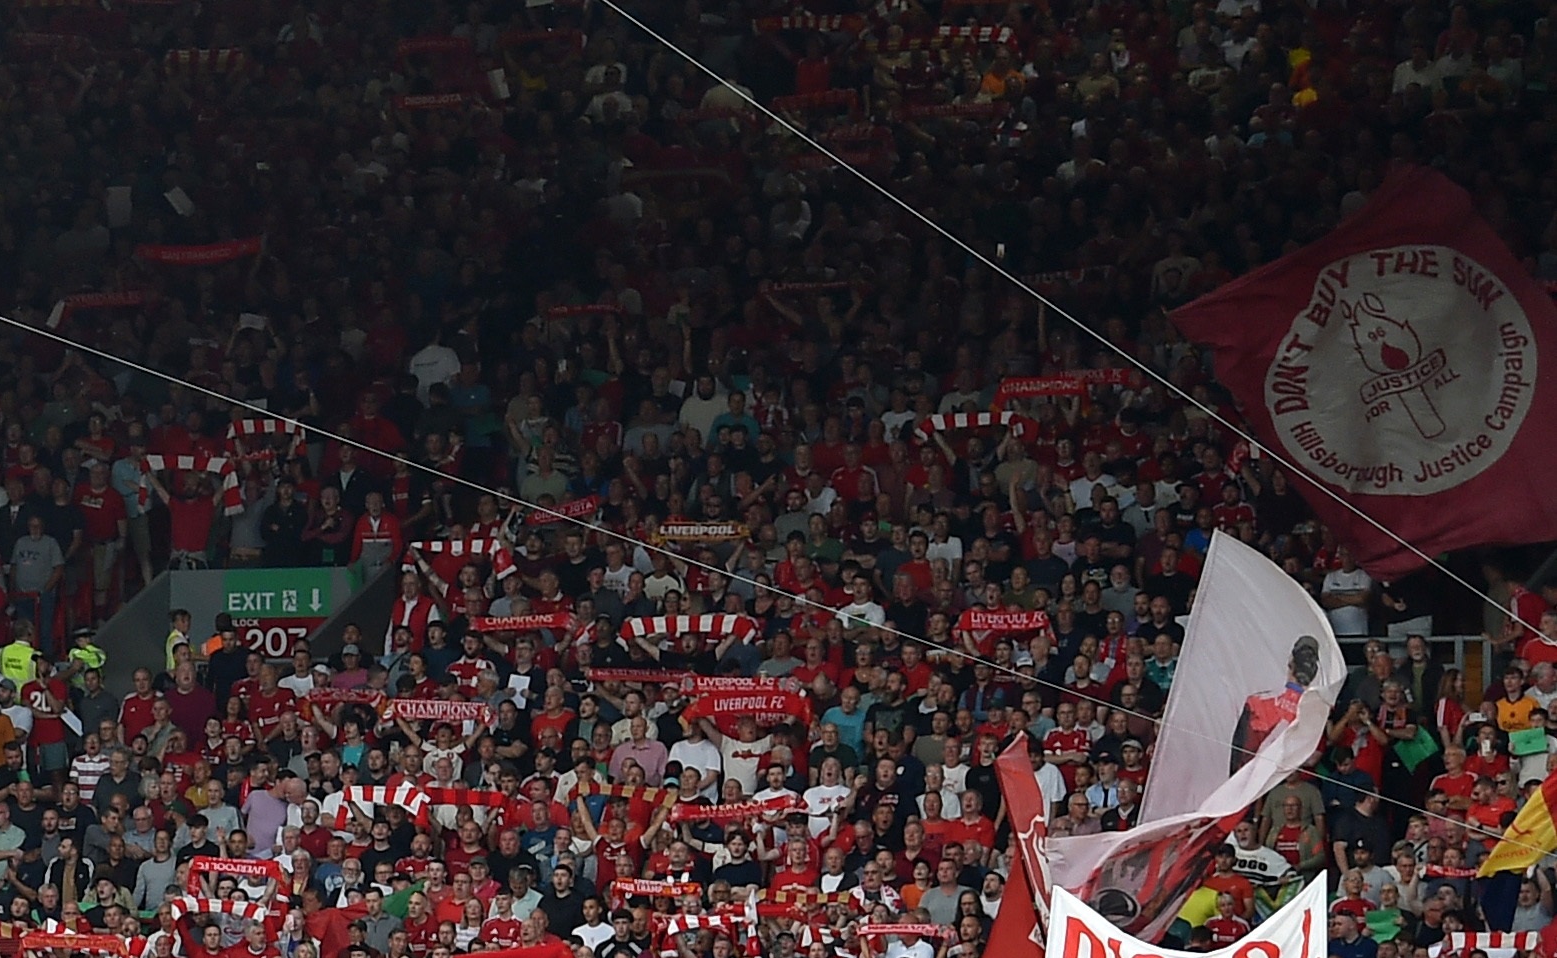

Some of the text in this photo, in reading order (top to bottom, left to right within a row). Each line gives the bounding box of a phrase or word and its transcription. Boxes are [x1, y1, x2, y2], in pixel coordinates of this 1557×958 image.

[1274, 250, 1503, 417] DON'T BUY THE SUN
[1367, 325, 1387, 342] 96
[1367, 351, 1446, 399] JUSTICE
[1001, 378, 1080, 394] CHAMPIONS
[1365, 366, 1461, 423] FOR ALL
[1290, 320, 1532, 489] Hillsborough Justice Campaign
[567, 501, 593, 515] JOTA
[659, 524, 736, 537] LIVERPOOL
[228, 592, 274, 611] EXIT
[485, 613, 554, 626] CHAMPIONS
[970, 610, 1045, 624] LIVERPOOL FC
[245, 628, 308, 658] 207
[697, 677, 775, 687] LIVERPOOL FC
[398, 702, 478, 717] CHAMPIONS
[714, 695, 785, 712] LIVERPOOL FC
[700, 799, 769, 812] LIVERPOOL
[211, 862, 266, 875] LIVERPOOL
